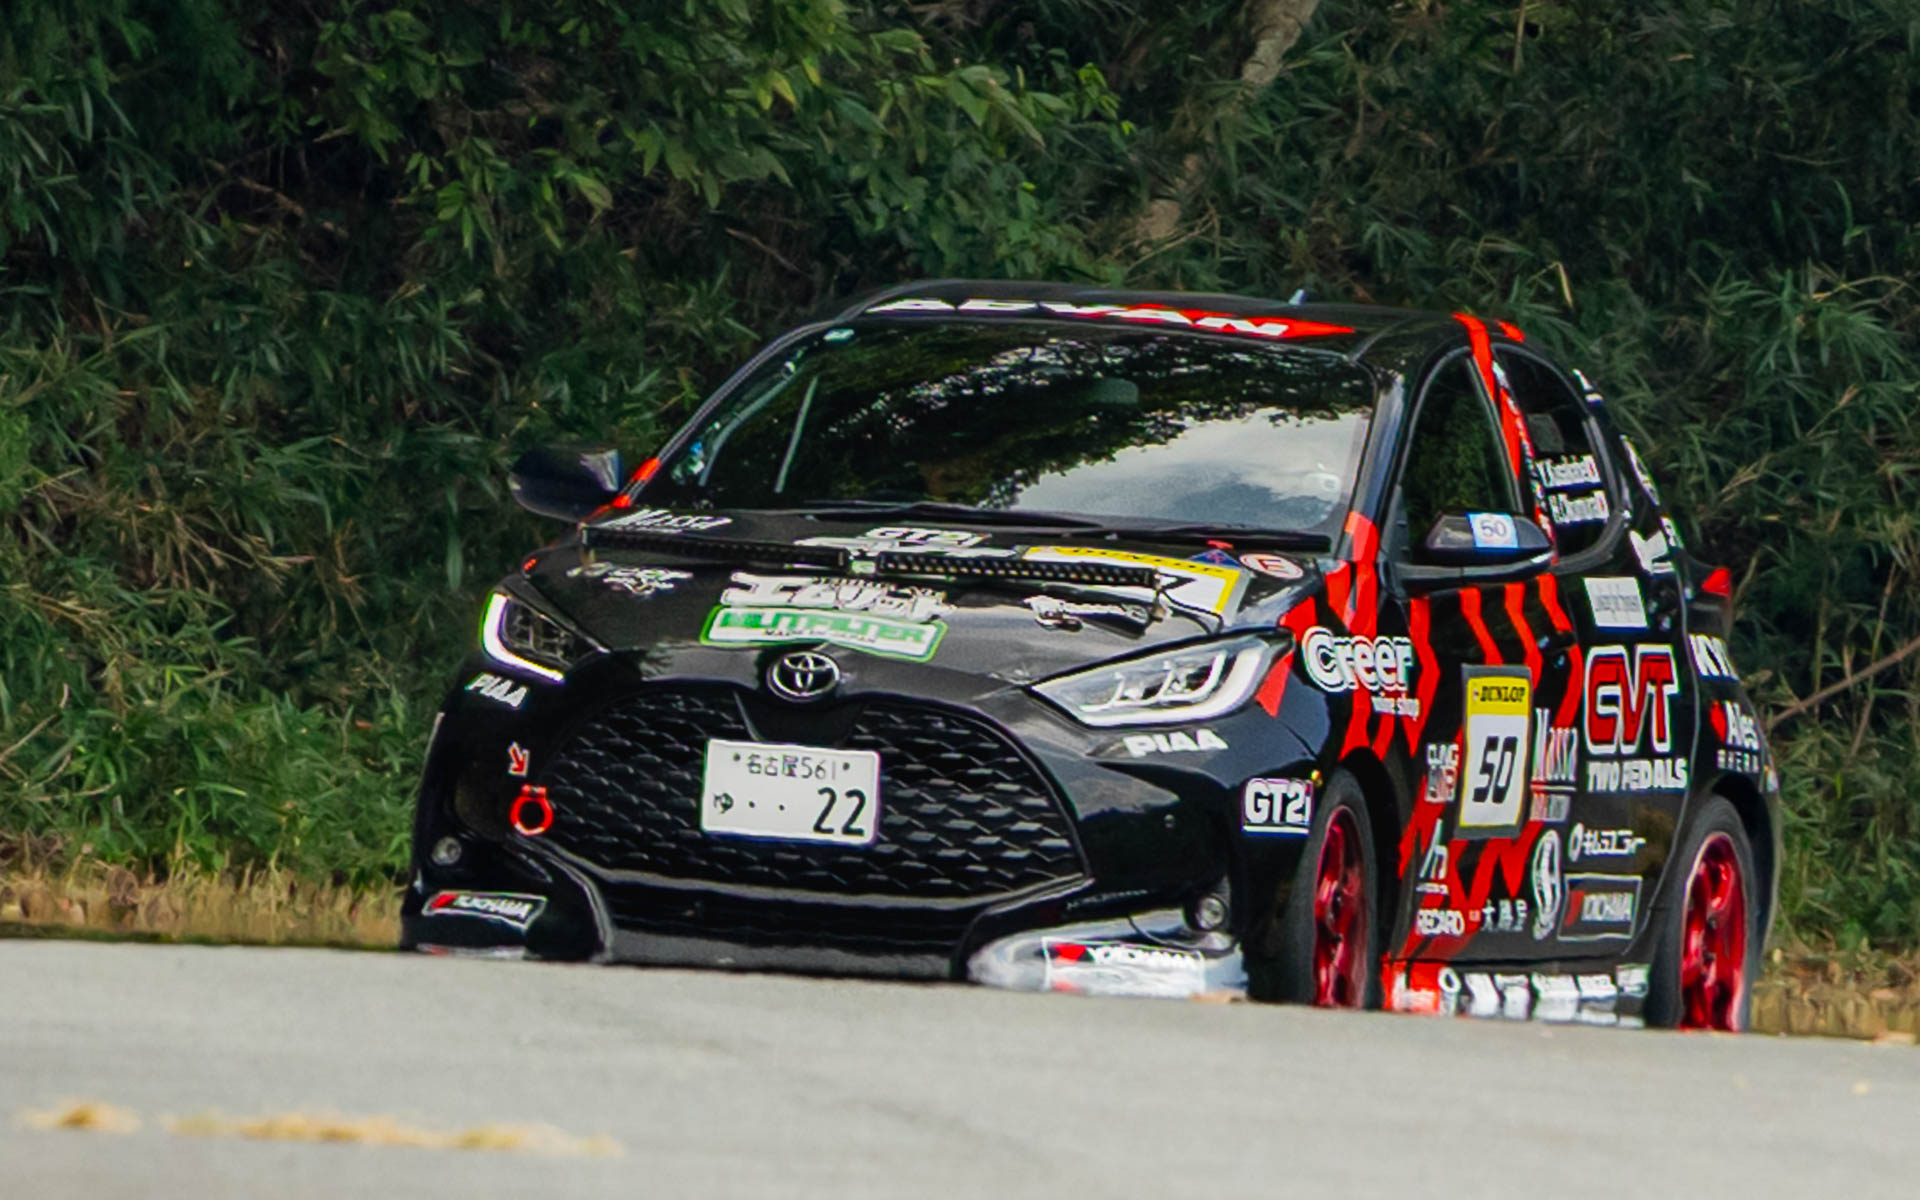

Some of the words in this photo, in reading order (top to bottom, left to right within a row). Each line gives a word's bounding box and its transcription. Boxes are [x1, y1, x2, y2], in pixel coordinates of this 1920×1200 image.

[1480, 519, 1508, 537] 50
[1302, 626, 1413, 692] Creer
[466, 672, 528, 708] PIAA
[1480, 686, 1526, 703] DUNLOP
[1583, 643, 1679, 755] CVT
[1122, 729, 1229, 758] PIAA
[1472, 736, 1519, 804] 50
[1586, 761, 1620, 793] TWO
[1622, 757, 1688, 791] PEDALS
[813, 787, 867, 837] 22
